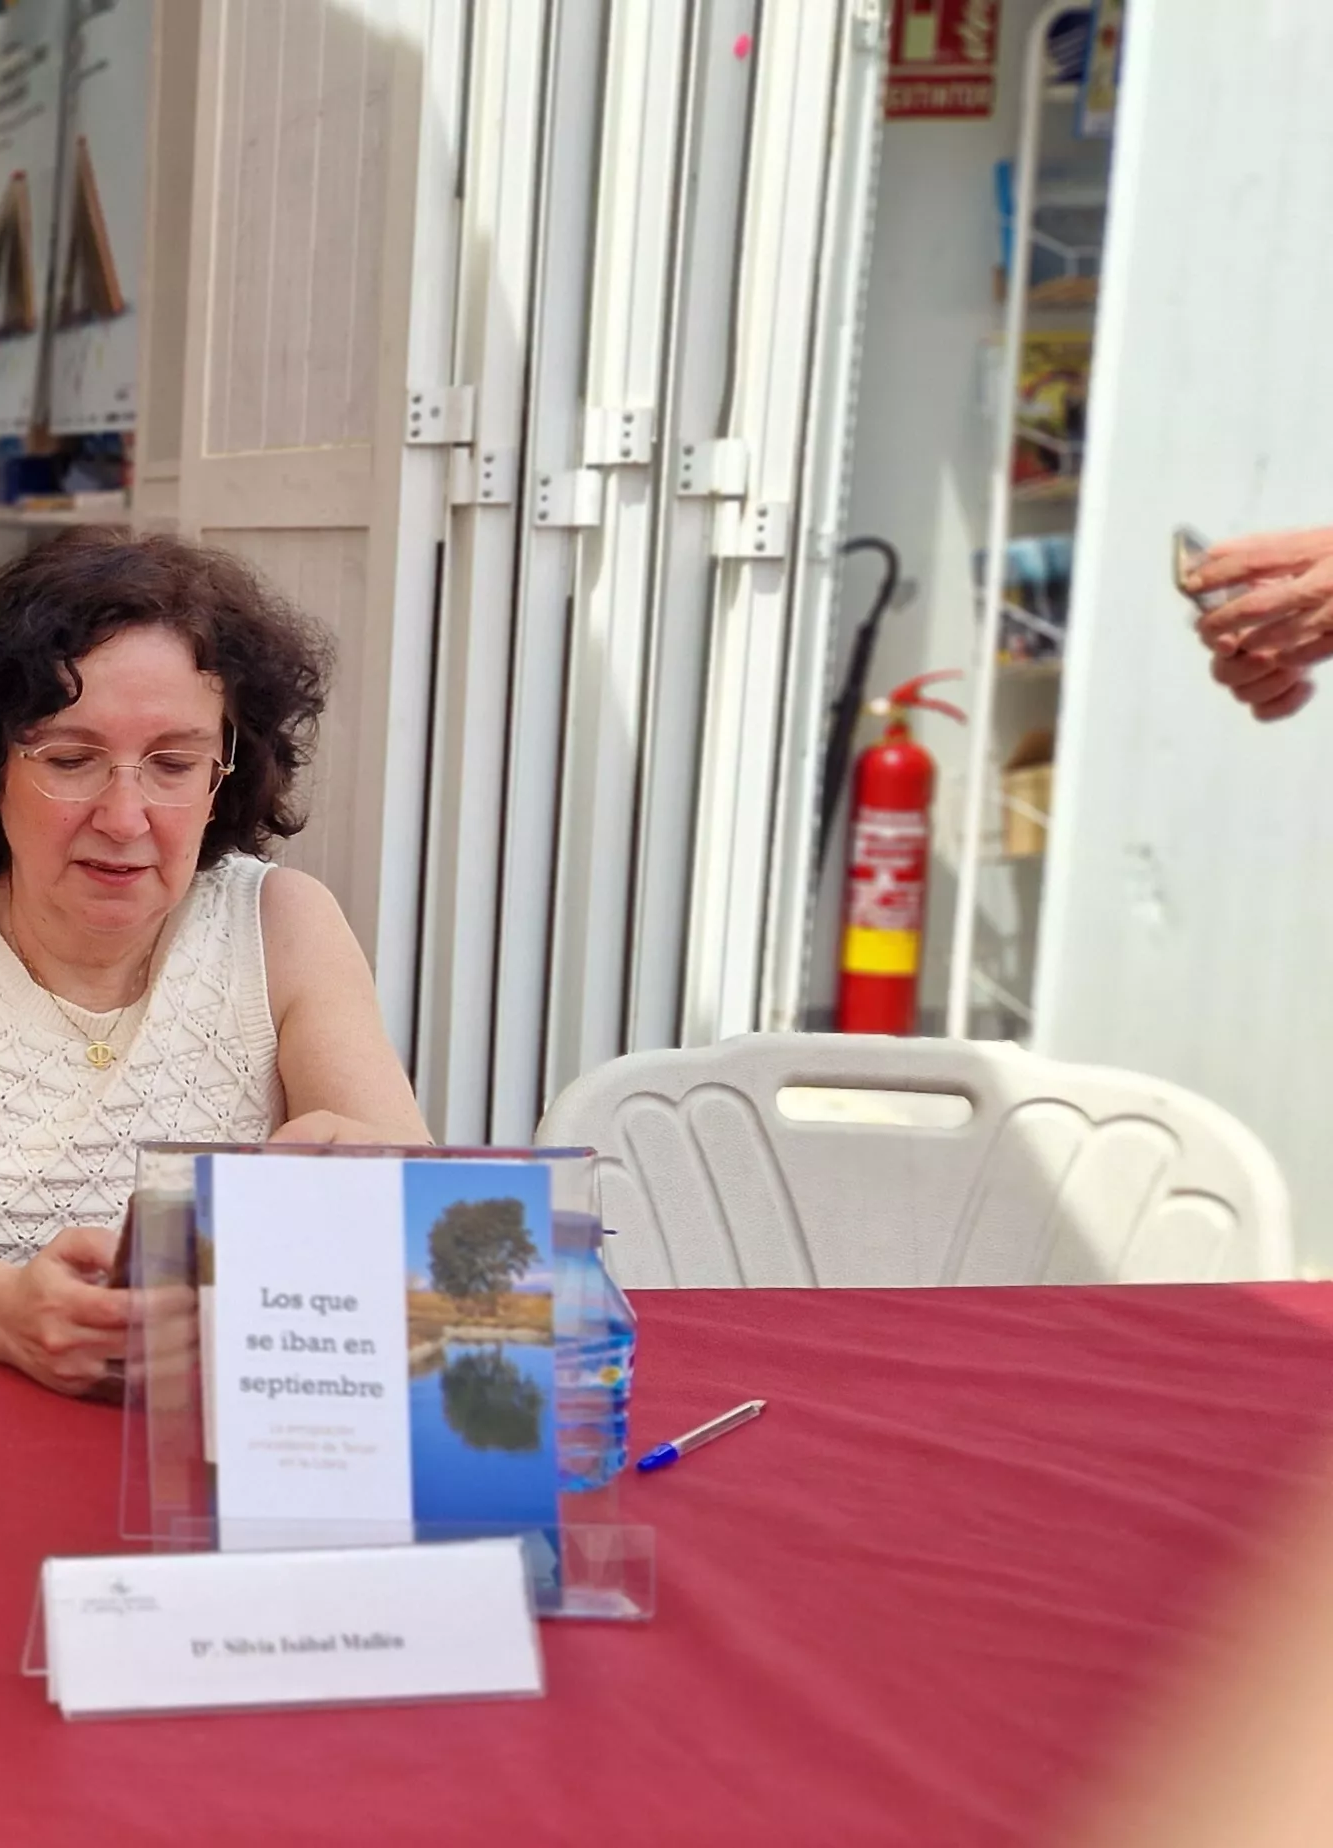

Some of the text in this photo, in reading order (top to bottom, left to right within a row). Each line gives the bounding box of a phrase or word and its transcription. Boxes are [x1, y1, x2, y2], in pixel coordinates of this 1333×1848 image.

[260, 1287, 359, 1317] Los que
[245, 1330, 377, 1355] se iban en
[239, 1373, 386, 1400] septiembre
[223, 1636, 276, 1656] Silvia
